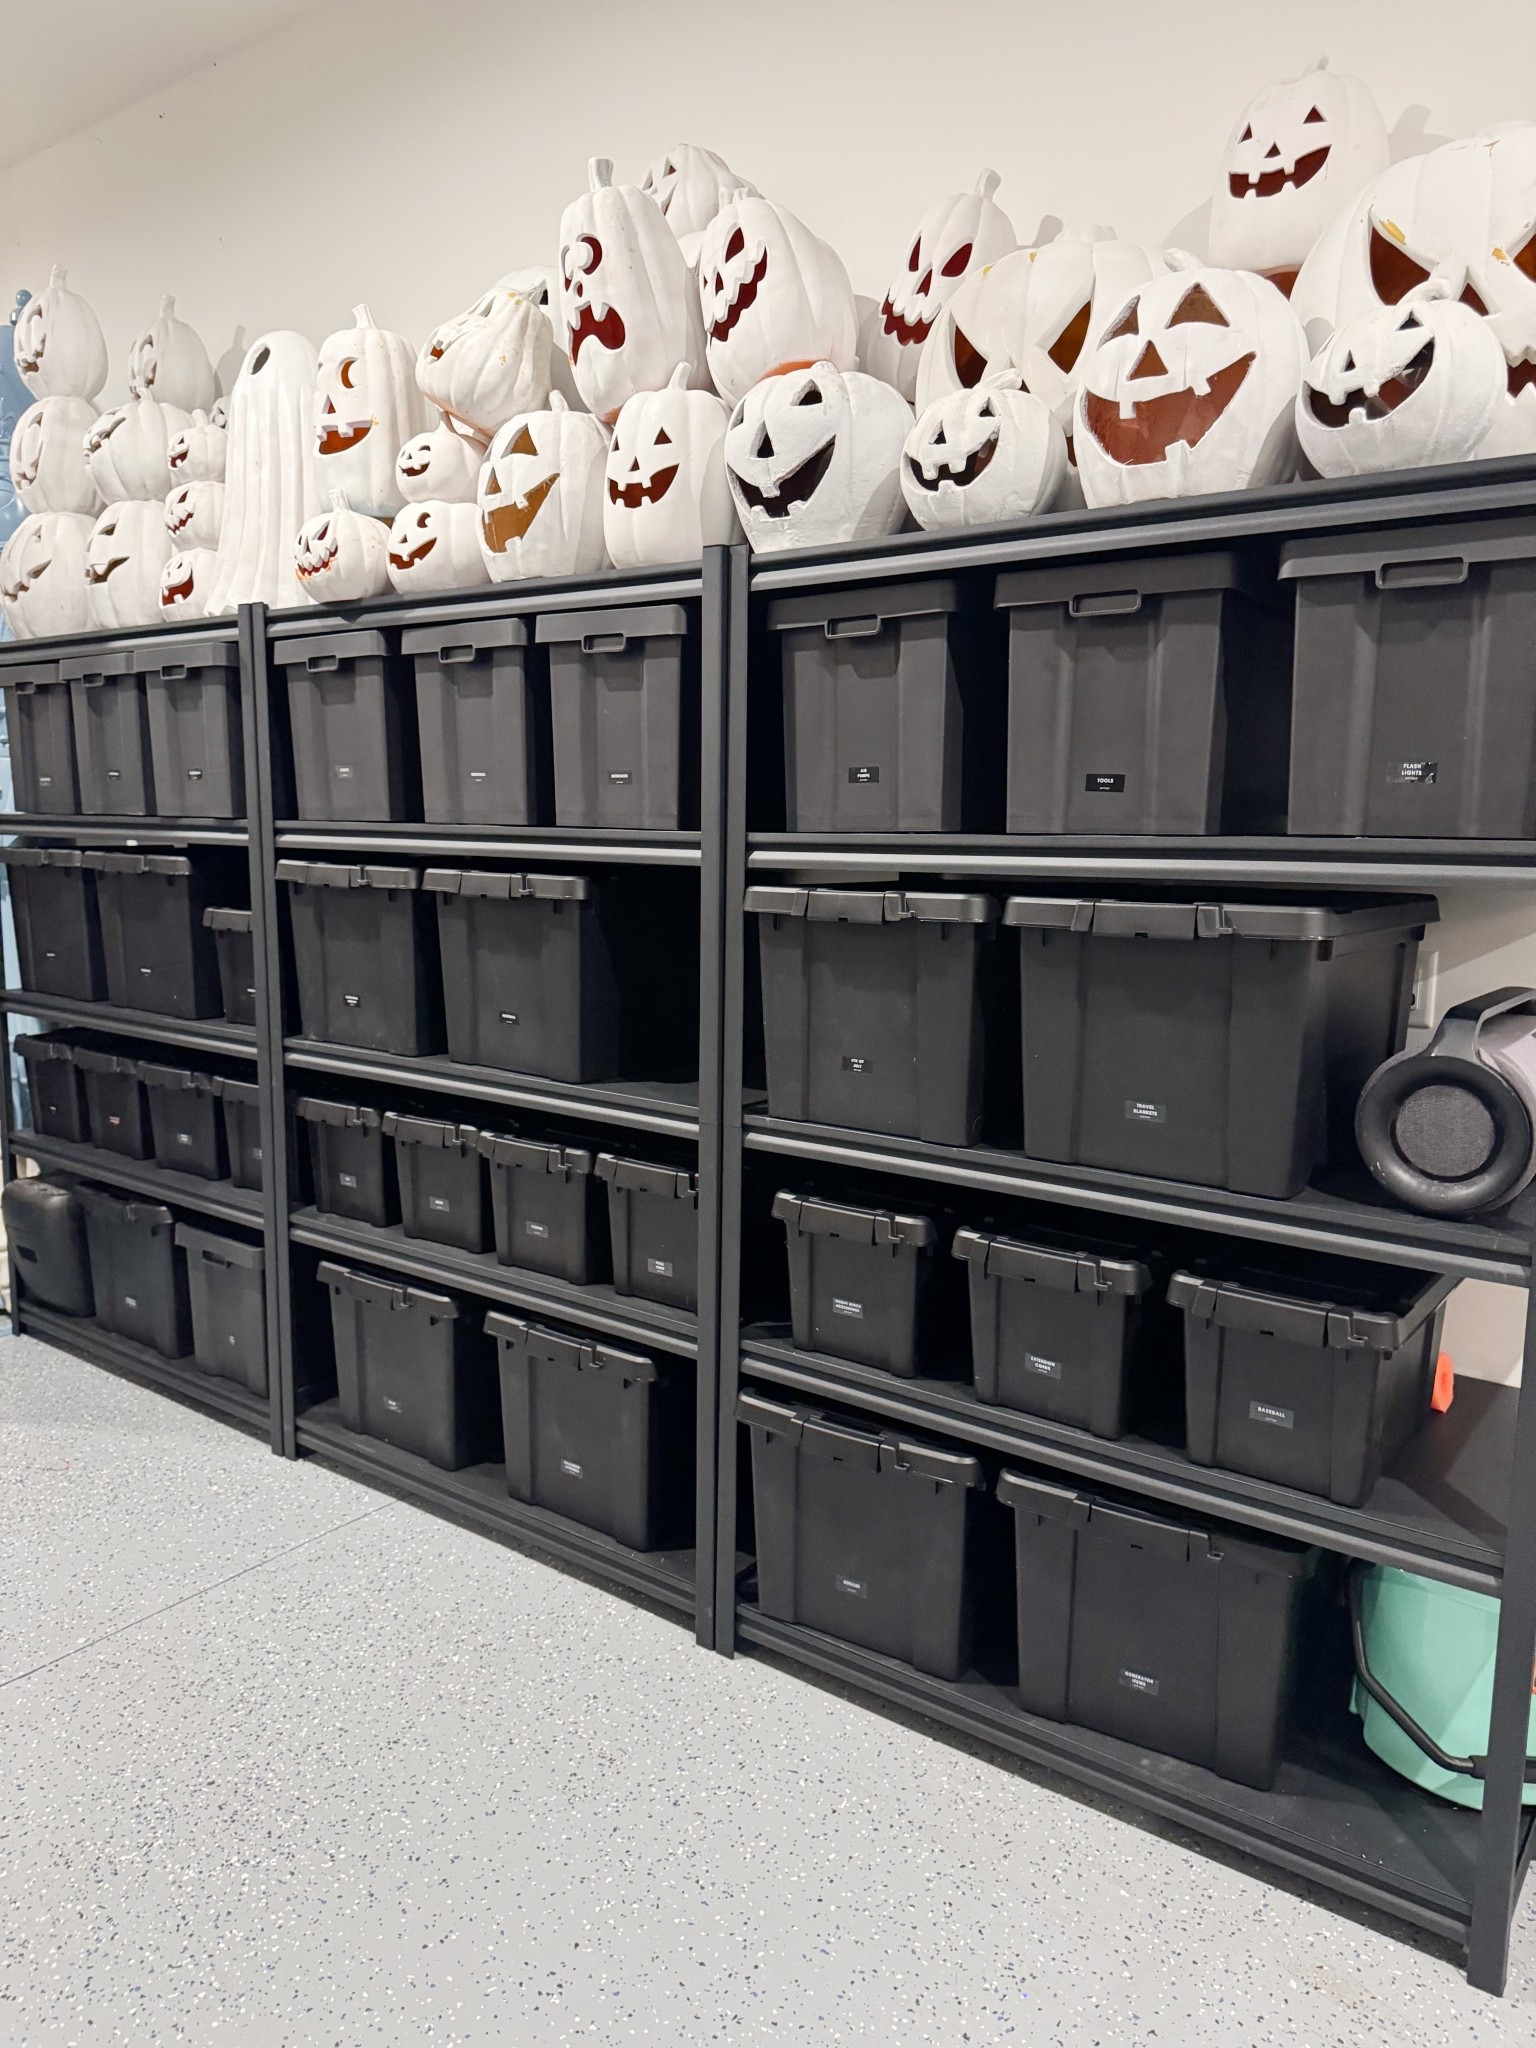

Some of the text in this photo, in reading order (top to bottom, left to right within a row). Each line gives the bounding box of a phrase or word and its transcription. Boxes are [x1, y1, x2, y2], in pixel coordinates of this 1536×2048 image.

[1133, 1108, 1158, 1116] BLANKETS
[1030, 1356, 1056, 1367] EXTENSION
[1035, 1362, 1051, 1371] CORDS
[1257, 1406, 1286, 1418] BASEBALL
[1124, 1671, 1154, 1684] GENERATOR
[1131, 1678, 1146, 1687] ITEMS
